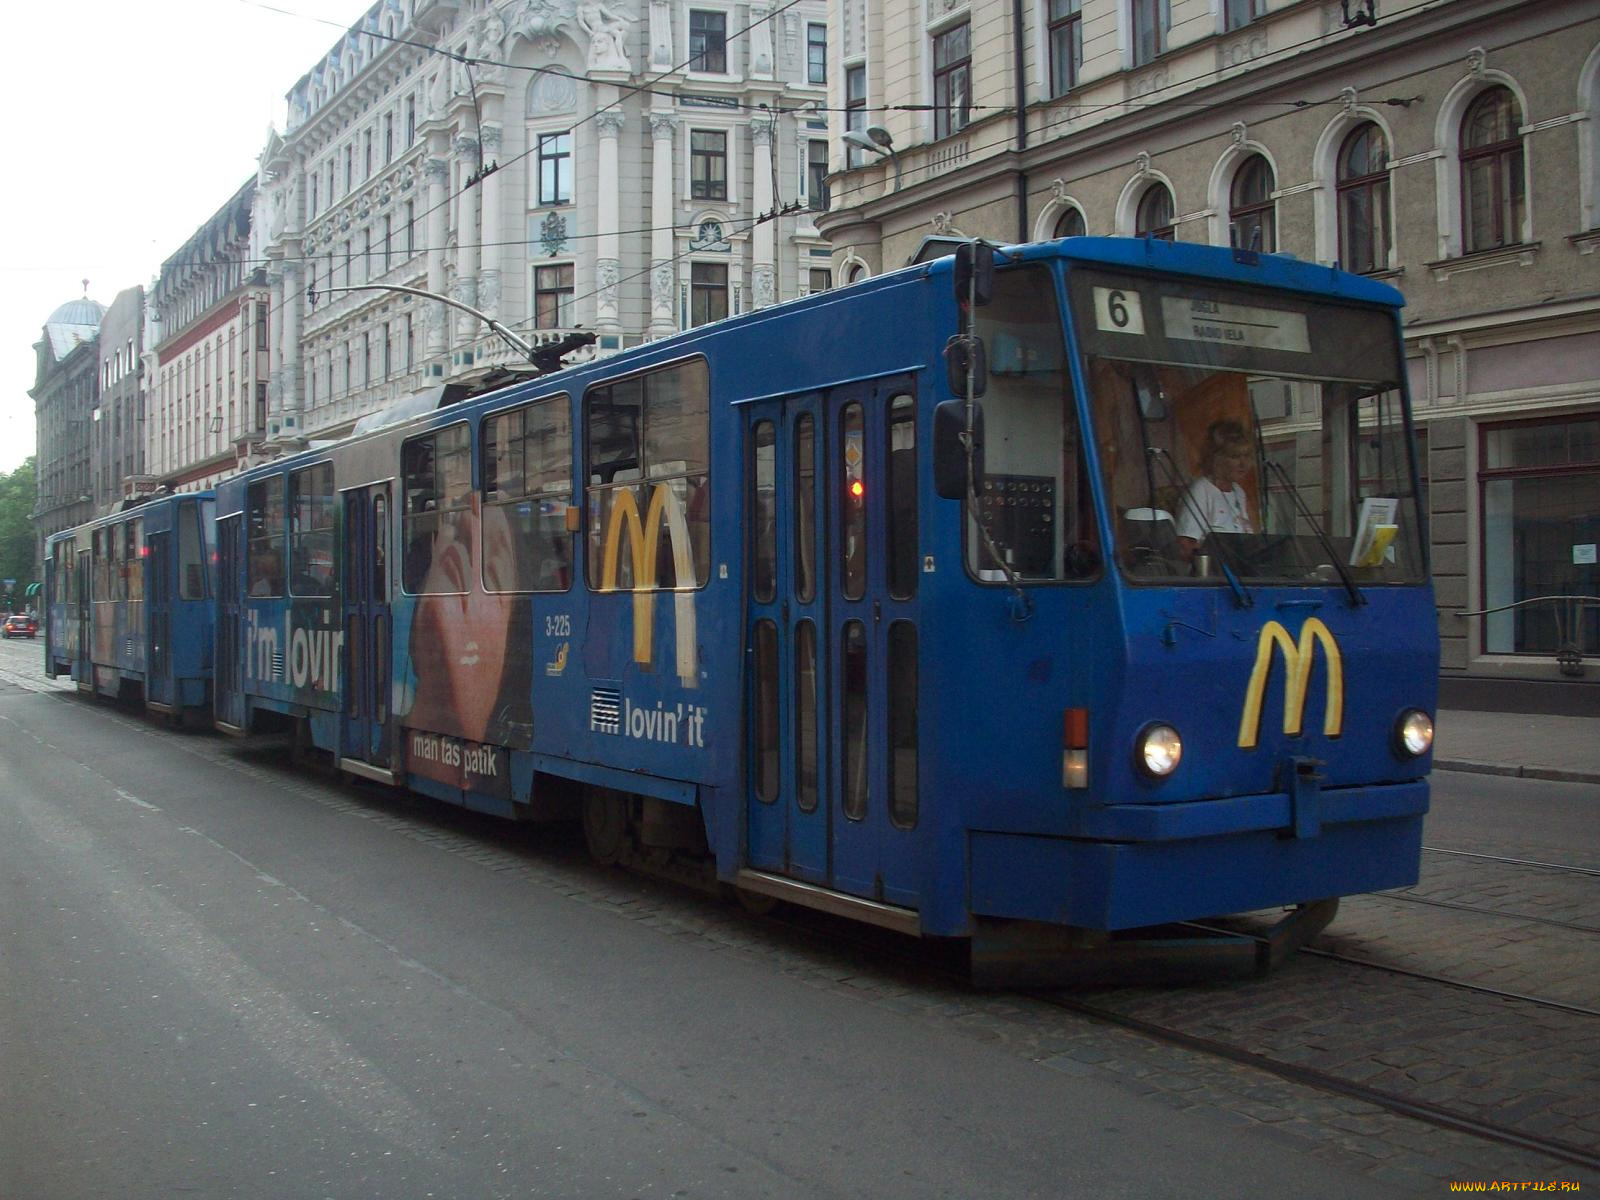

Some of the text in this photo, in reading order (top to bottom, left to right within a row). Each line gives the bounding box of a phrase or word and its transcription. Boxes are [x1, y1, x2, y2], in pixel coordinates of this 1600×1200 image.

[1108, 290, 1129, 328] 6
[545, 614, 571, 637] 3-225
[414, 736, 438, 761] man
[441, 737, 461, 767] tas
